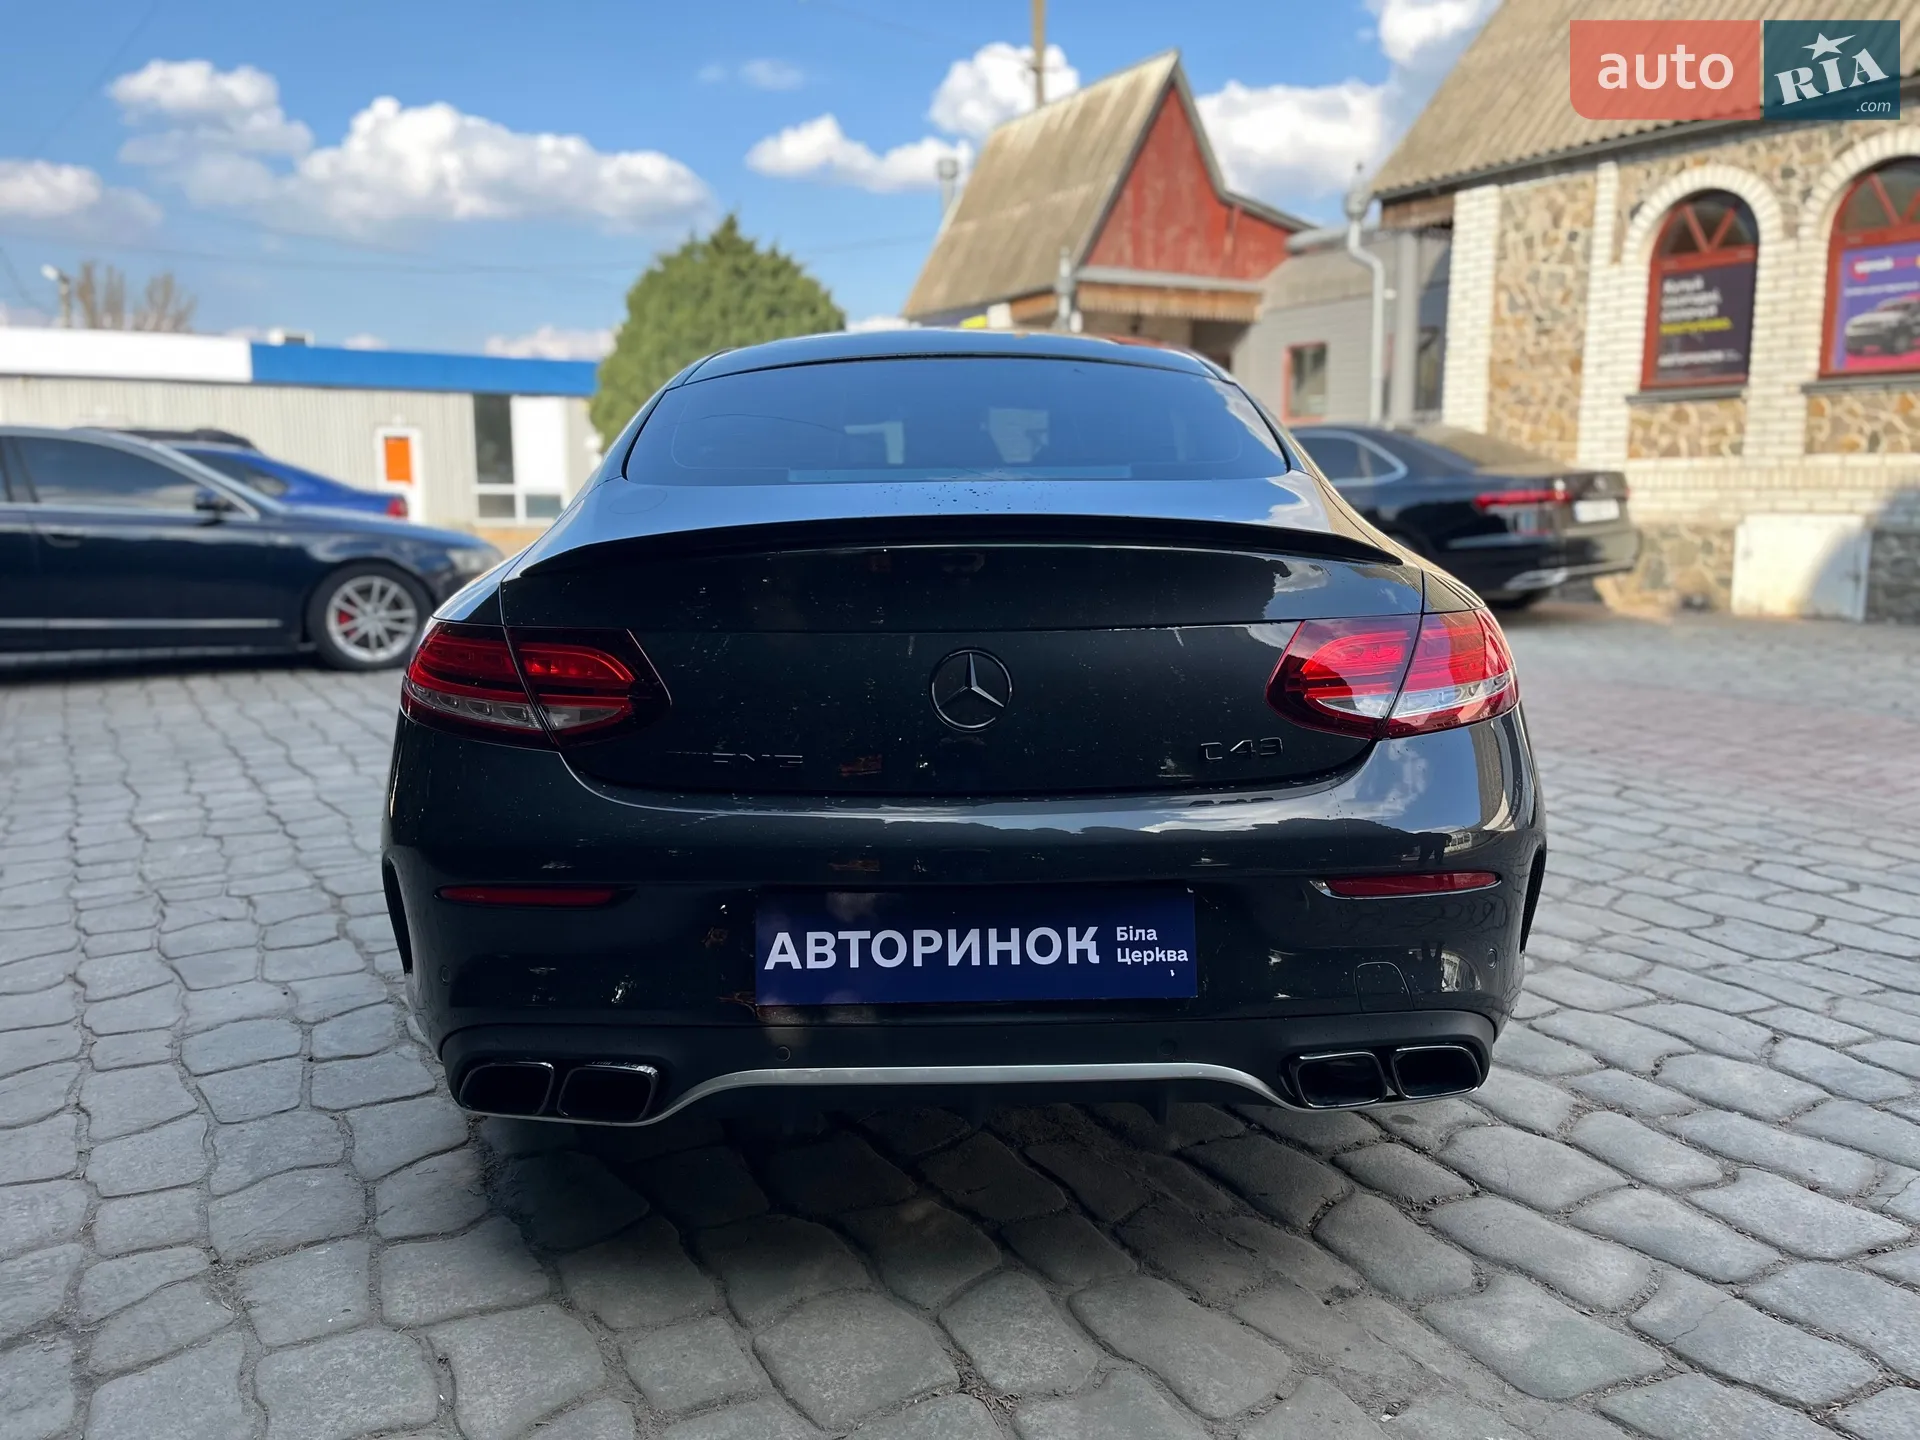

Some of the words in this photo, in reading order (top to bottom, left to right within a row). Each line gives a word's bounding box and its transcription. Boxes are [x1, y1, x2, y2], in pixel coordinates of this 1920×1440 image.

[1116, 925, 1158, 942] Біла
[763, 926, 1101, 970] АВТОРИНОК
[1116, 946, 1190, 965] Церква
